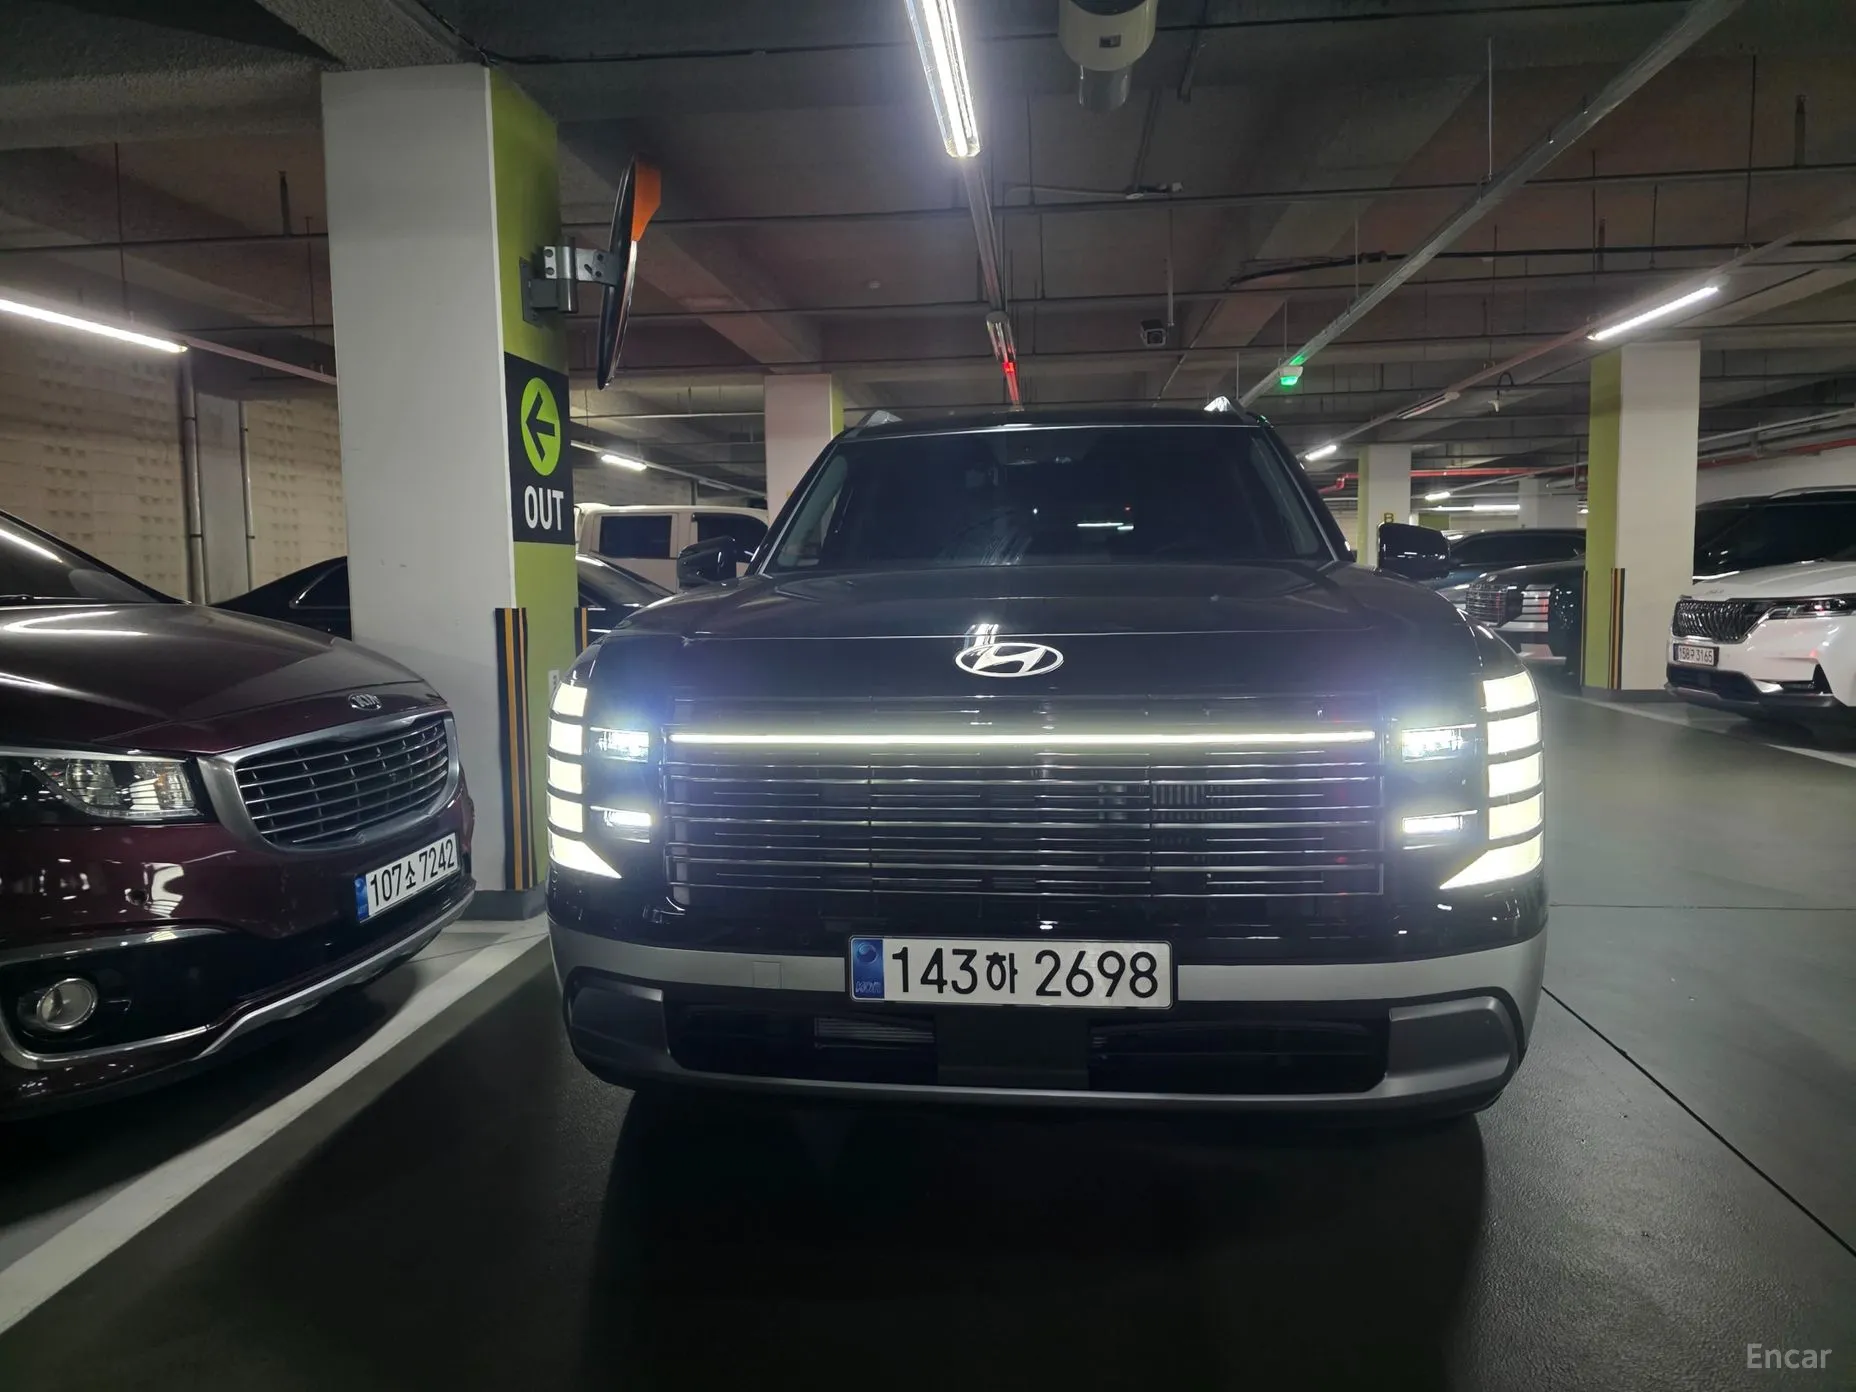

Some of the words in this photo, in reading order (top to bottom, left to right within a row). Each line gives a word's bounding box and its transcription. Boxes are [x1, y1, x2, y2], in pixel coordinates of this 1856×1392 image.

[524, 485, 564, 531] OUT
[370, 861, 416, 907] 107소
[419, 839, 455, 883] 7242
[892, 946, 1018, 995] 143하
[1035, 949, 1158, 998] 2698
